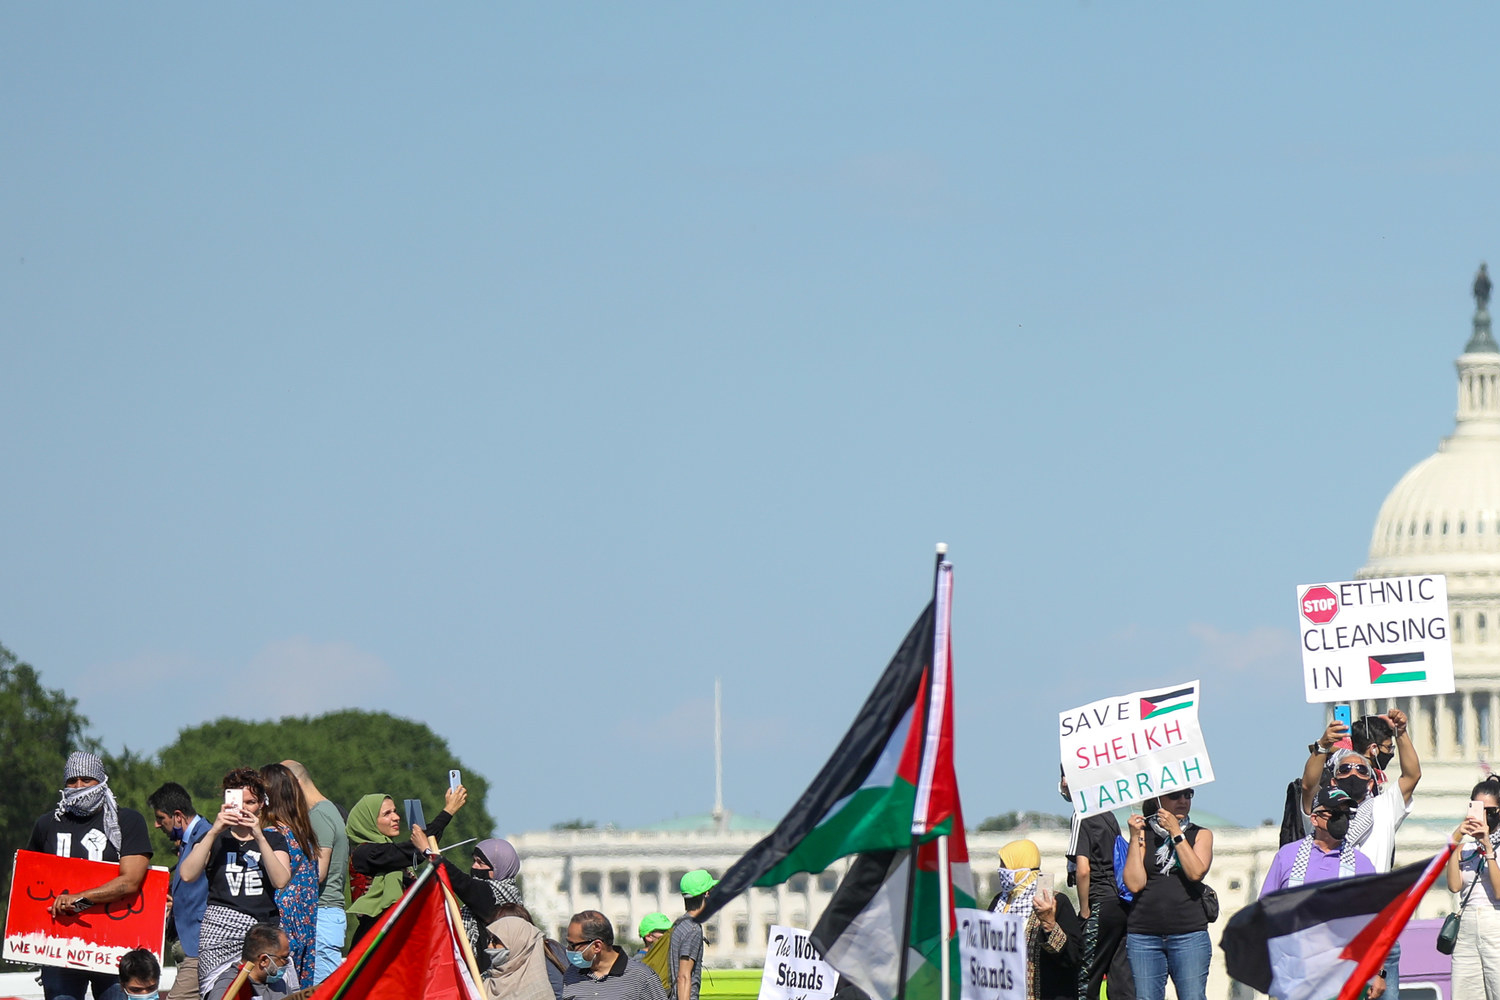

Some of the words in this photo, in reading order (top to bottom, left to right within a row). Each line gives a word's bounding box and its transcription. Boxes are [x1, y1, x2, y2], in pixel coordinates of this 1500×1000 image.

[1303, 597, 1336, 613] STOP
[1339, 577, 1435, 607] ETHNIC
[1303, 616, 1446, 652] CLEANSING
[1312, 665, 1343, 690] IN
[1061, 701, 1130, 737] SAVE
[1076, 719, 1183, 769] SHEIKH
[1079, 757, 1203, 814] JARRAH
[9, 939, 31, 954] WE
[34, 943, 62, 959] WILL
[66, 948, 93, 966] NOT
[95, 950, 112, 966] BE
[774, 934, 792, 958] The
[793, 934, 825, 962] Wor
[978, 919, 1018, 953] World
[776, 962, 825, 991] Stands
[969, 955, 1014, 991] Stands
